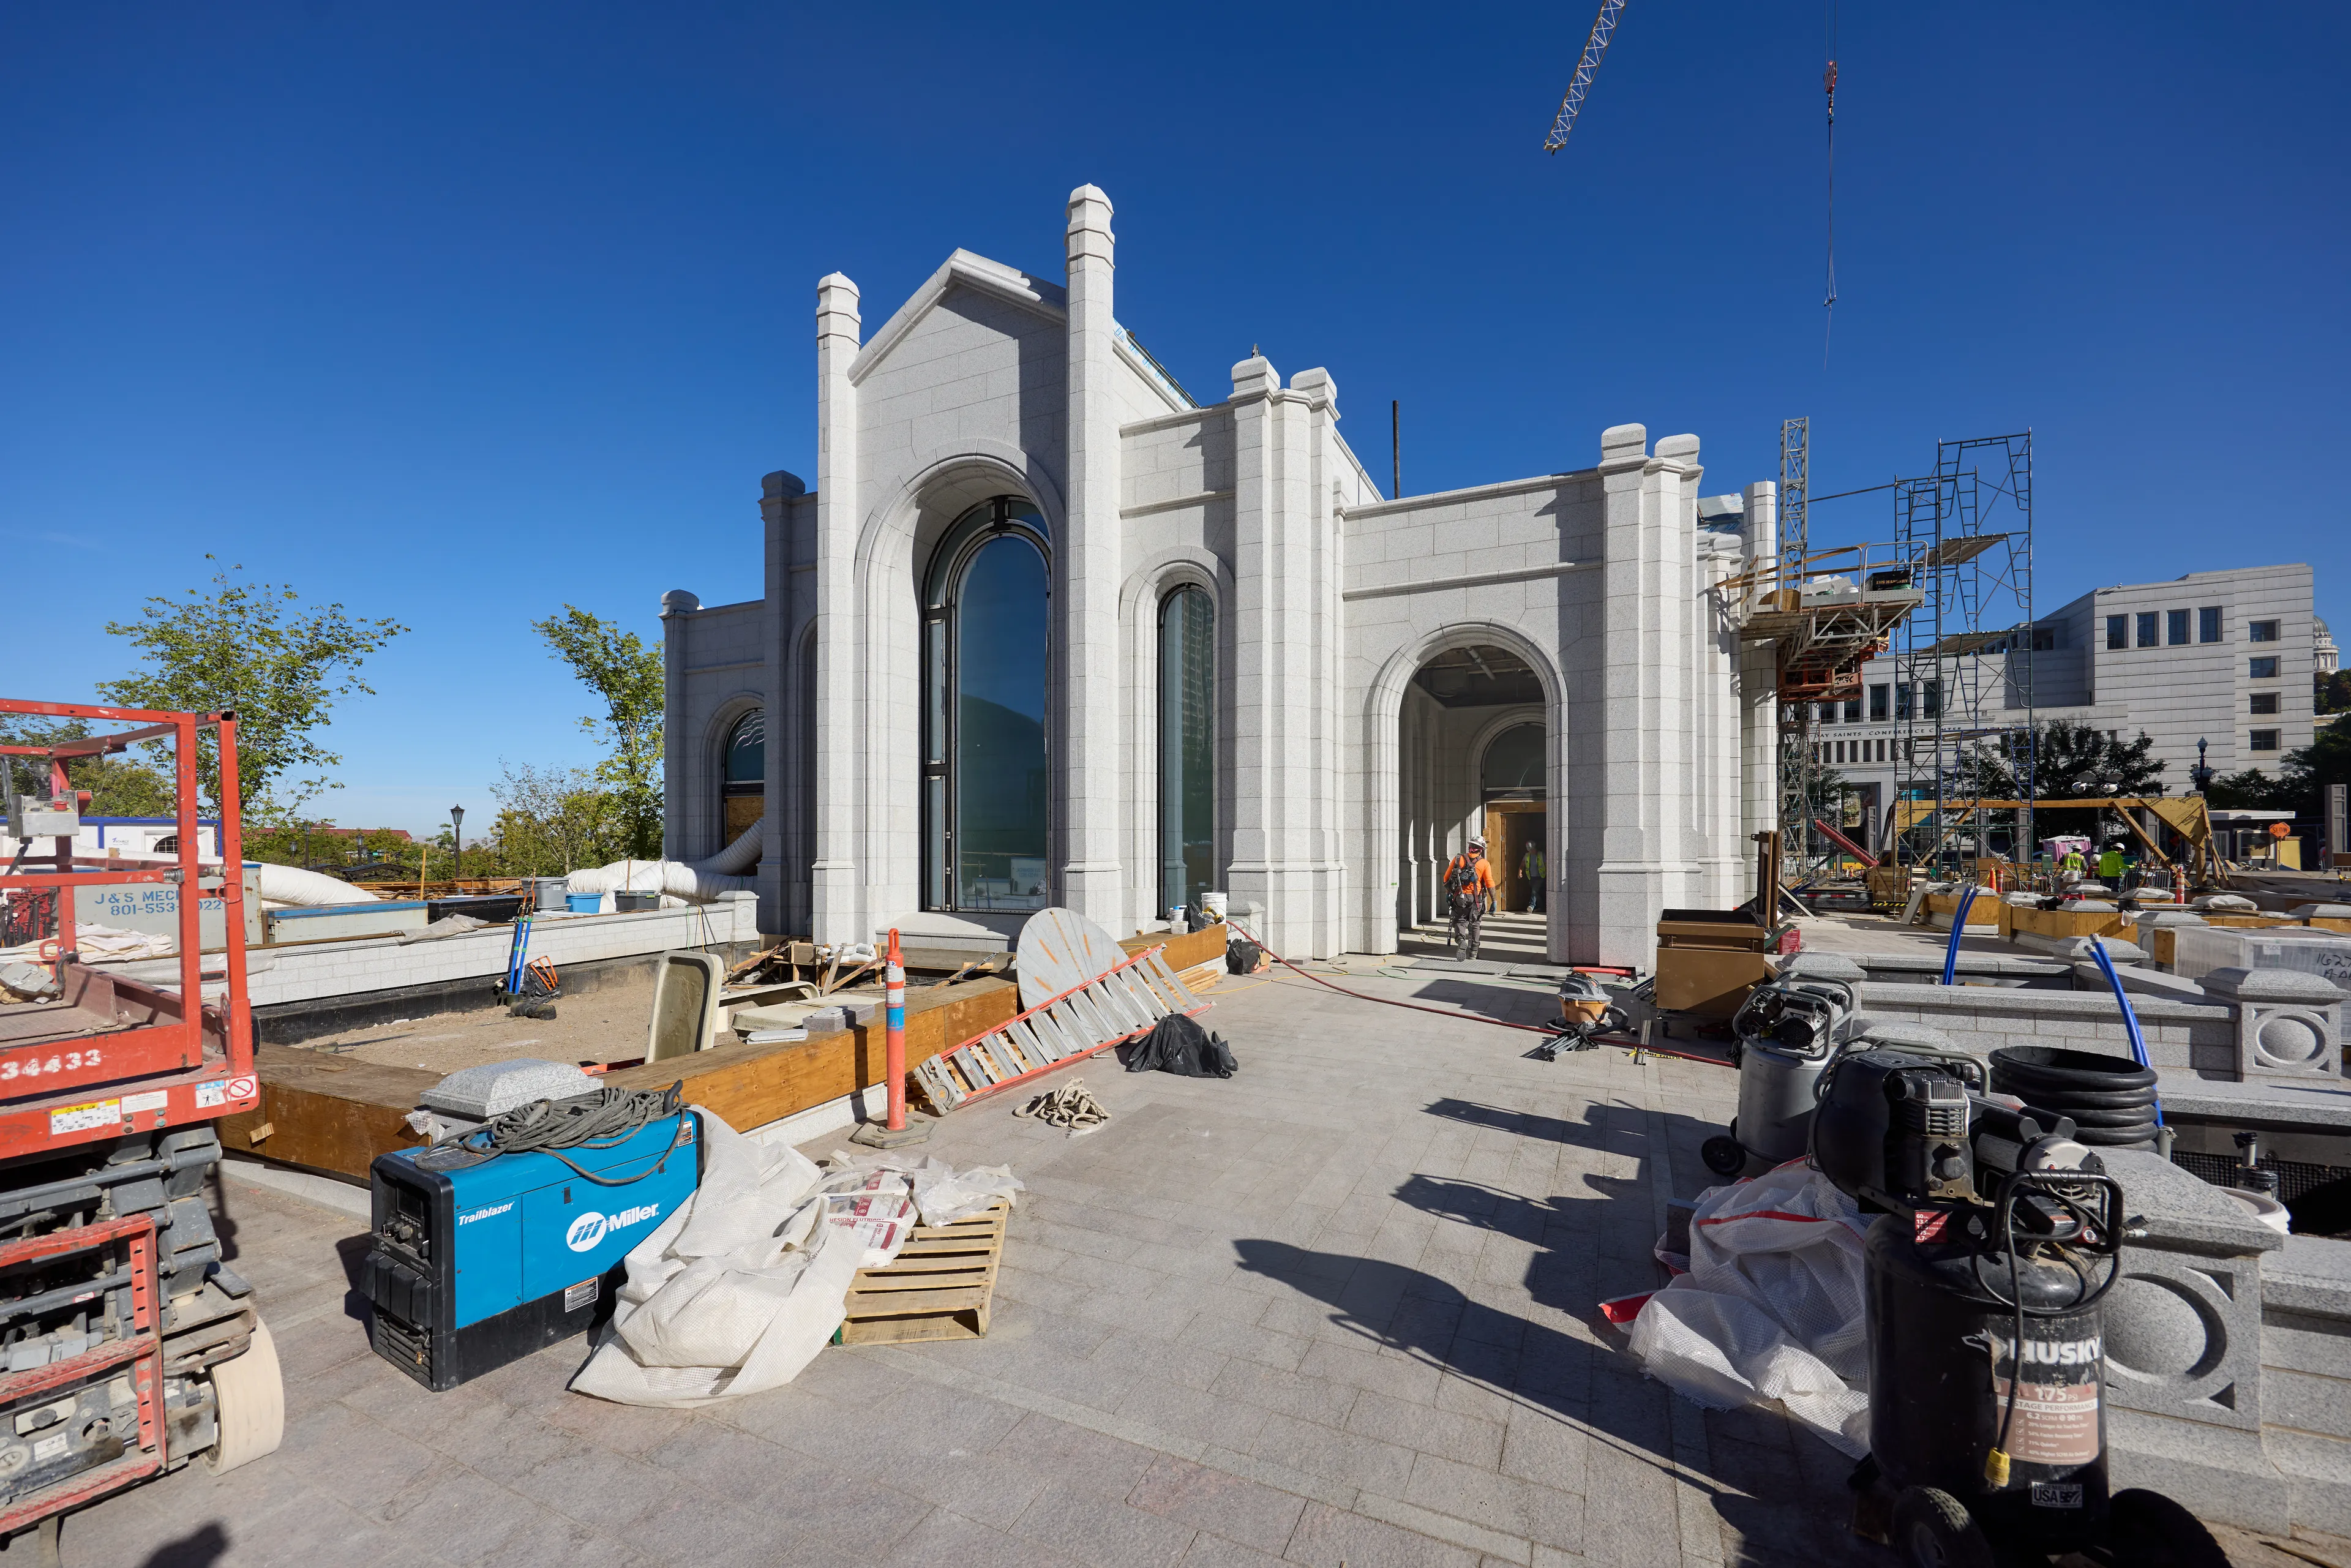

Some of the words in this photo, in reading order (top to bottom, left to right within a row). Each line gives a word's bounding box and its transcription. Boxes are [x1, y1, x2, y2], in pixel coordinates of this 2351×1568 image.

[94, 893, 105, 904] J
[108, 893, 120, 904] &
[124, 893, 134, 903] S
[110, 899, 222, 916] 801-553-22
[0, 1049, 101, 1079] 34433
[459, 1201, 515, 1226] Trailblazer
[609, 1203, 659, 1231] Miller
[2009, 1336, 2101, 1365] HUSKY
[2034, 1387, 2067, 1402] 175
[2045, 1401, 2094, 1411] PERFORMANCE
[2034, 1488, 2058, 1503] USA
